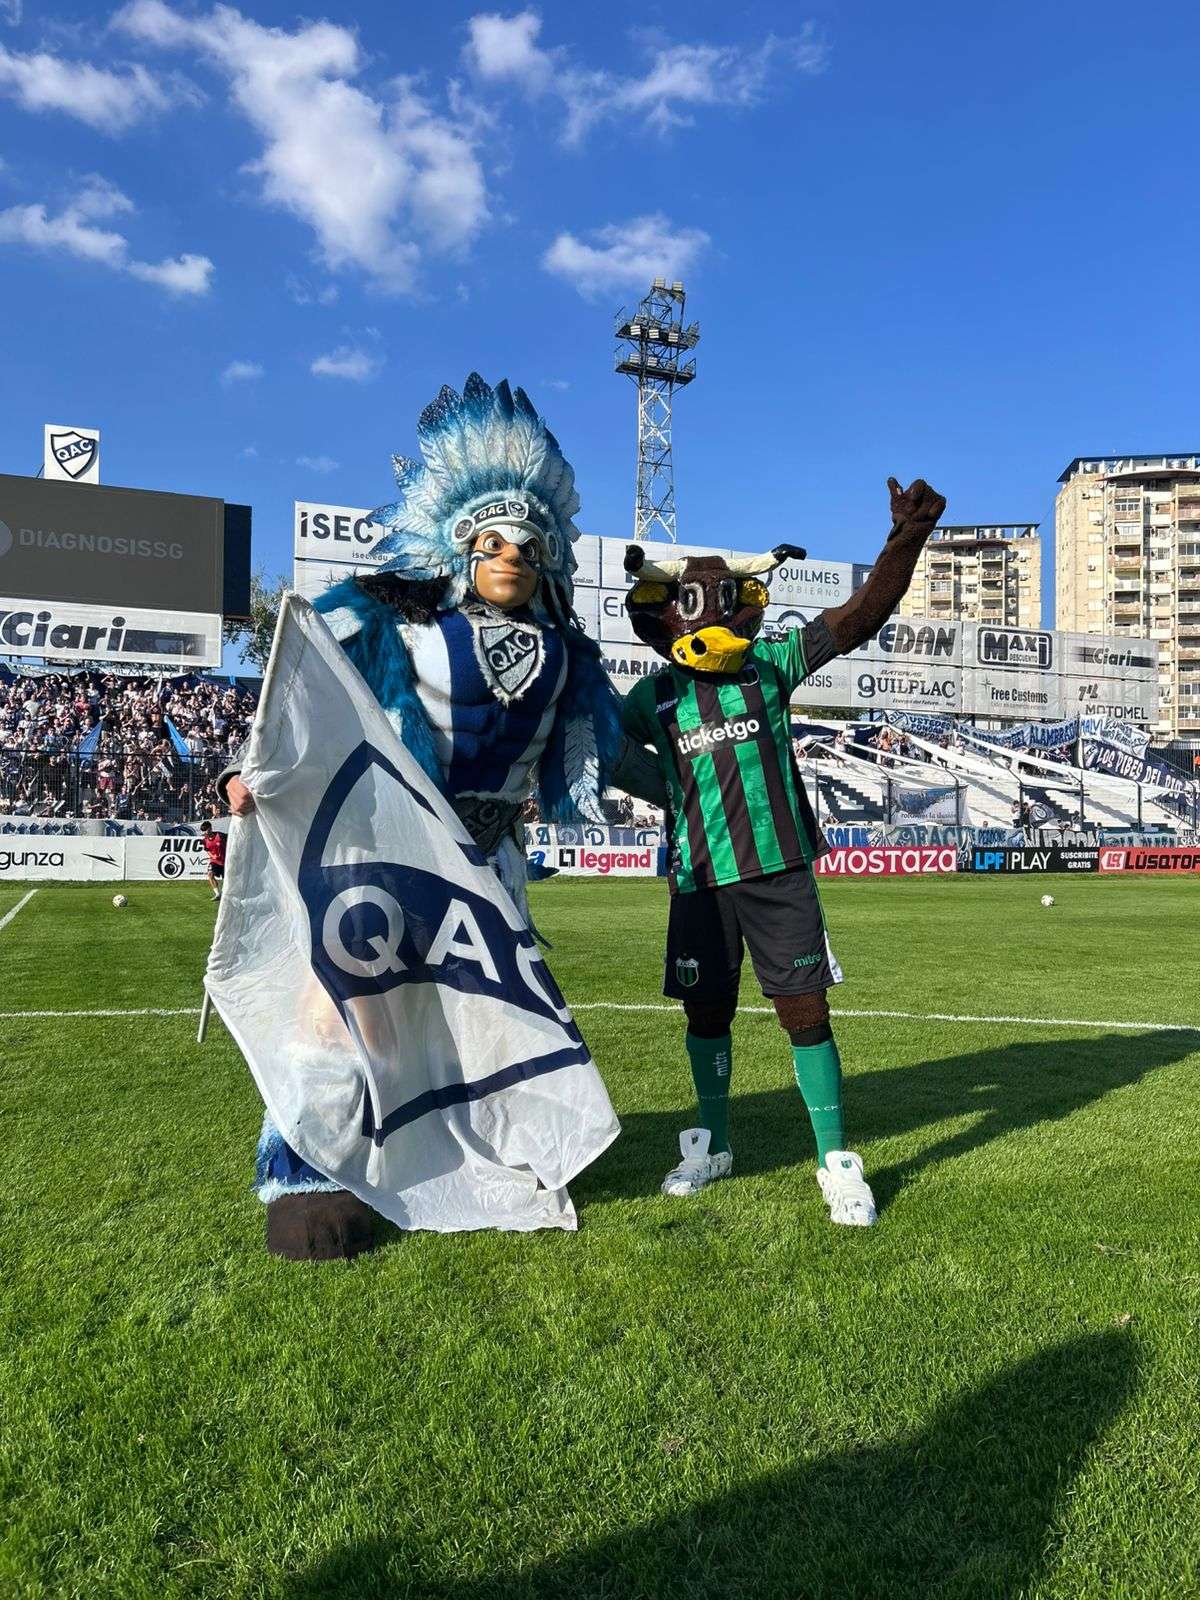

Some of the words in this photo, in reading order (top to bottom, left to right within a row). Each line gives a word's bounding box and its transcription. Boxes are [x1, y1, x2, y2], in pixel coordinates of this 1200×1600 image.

[56, 438, 92, 461] QAC
[479, 505, 504, 519] QAC
[300, 511, 374, 544] iSEC
[779, 567, 841, 585] QUILMES
[778, 584, 841, 598] GOBIERNO
[0, 610, 126, 652] Ciari
[488, 631, 534, 672] QAC
[1008, 652, 1039, 664] DESCUENTO
[1093, 647, 1132, 667] Ciari
[857, 673, 956, 698] QUILPLAC
[991, 686, 1011, 702] Free
[1012, 688, 1048, 705] Customs
[1085, 704, 1149, 720] MOTOMEL
[677, 718, 760, 754] ticketgo
[1096, 747, 1114, 768] LOS
[1115, 751, 1144, 781] PIBES
[160, 838, 204, 853] AVIC
[1060, 851, 1099, 860] SUSCRIBITE
[580, 848, 651, 873] legrand
[975, 851, 1005, 871] LPF
[1011, 852, 1052, 870] PLAY
[1067, 861, 1092, 869] GRATIS
[322, 884, 572, 1023] QAC
[794, 953, 822, 969] mitre
[715, 1050, 728, 1078] mitre
